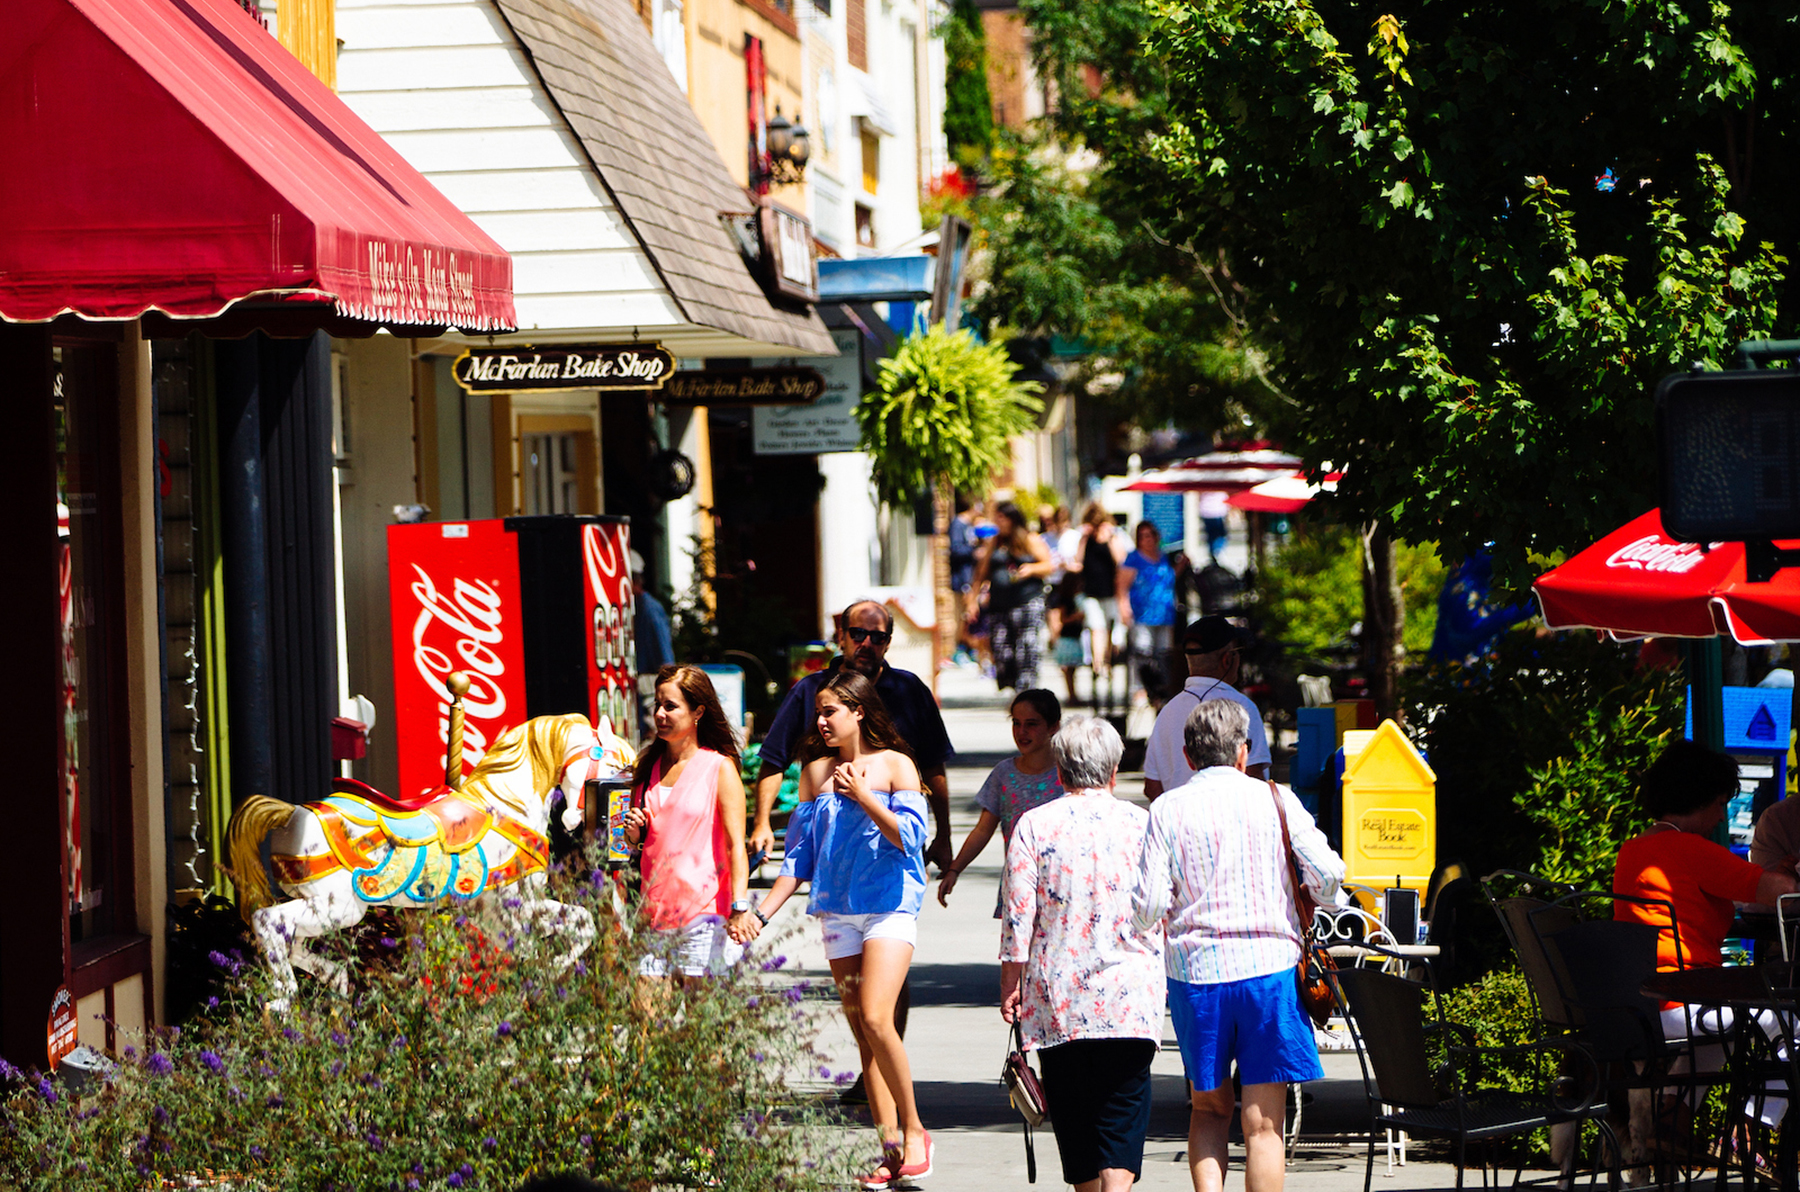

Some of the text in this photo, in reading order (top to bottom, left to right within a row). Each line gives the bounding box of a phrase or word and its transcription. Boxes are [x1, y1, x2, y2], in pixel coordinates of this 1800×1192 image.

[368, 241, 477, 316] Mike's On Main Street
[463, 351, 665, 382] McFarlan Bake Shop
[1362, 818, 1387, 831] Real
[1378, 830, 1408, 842] Book
